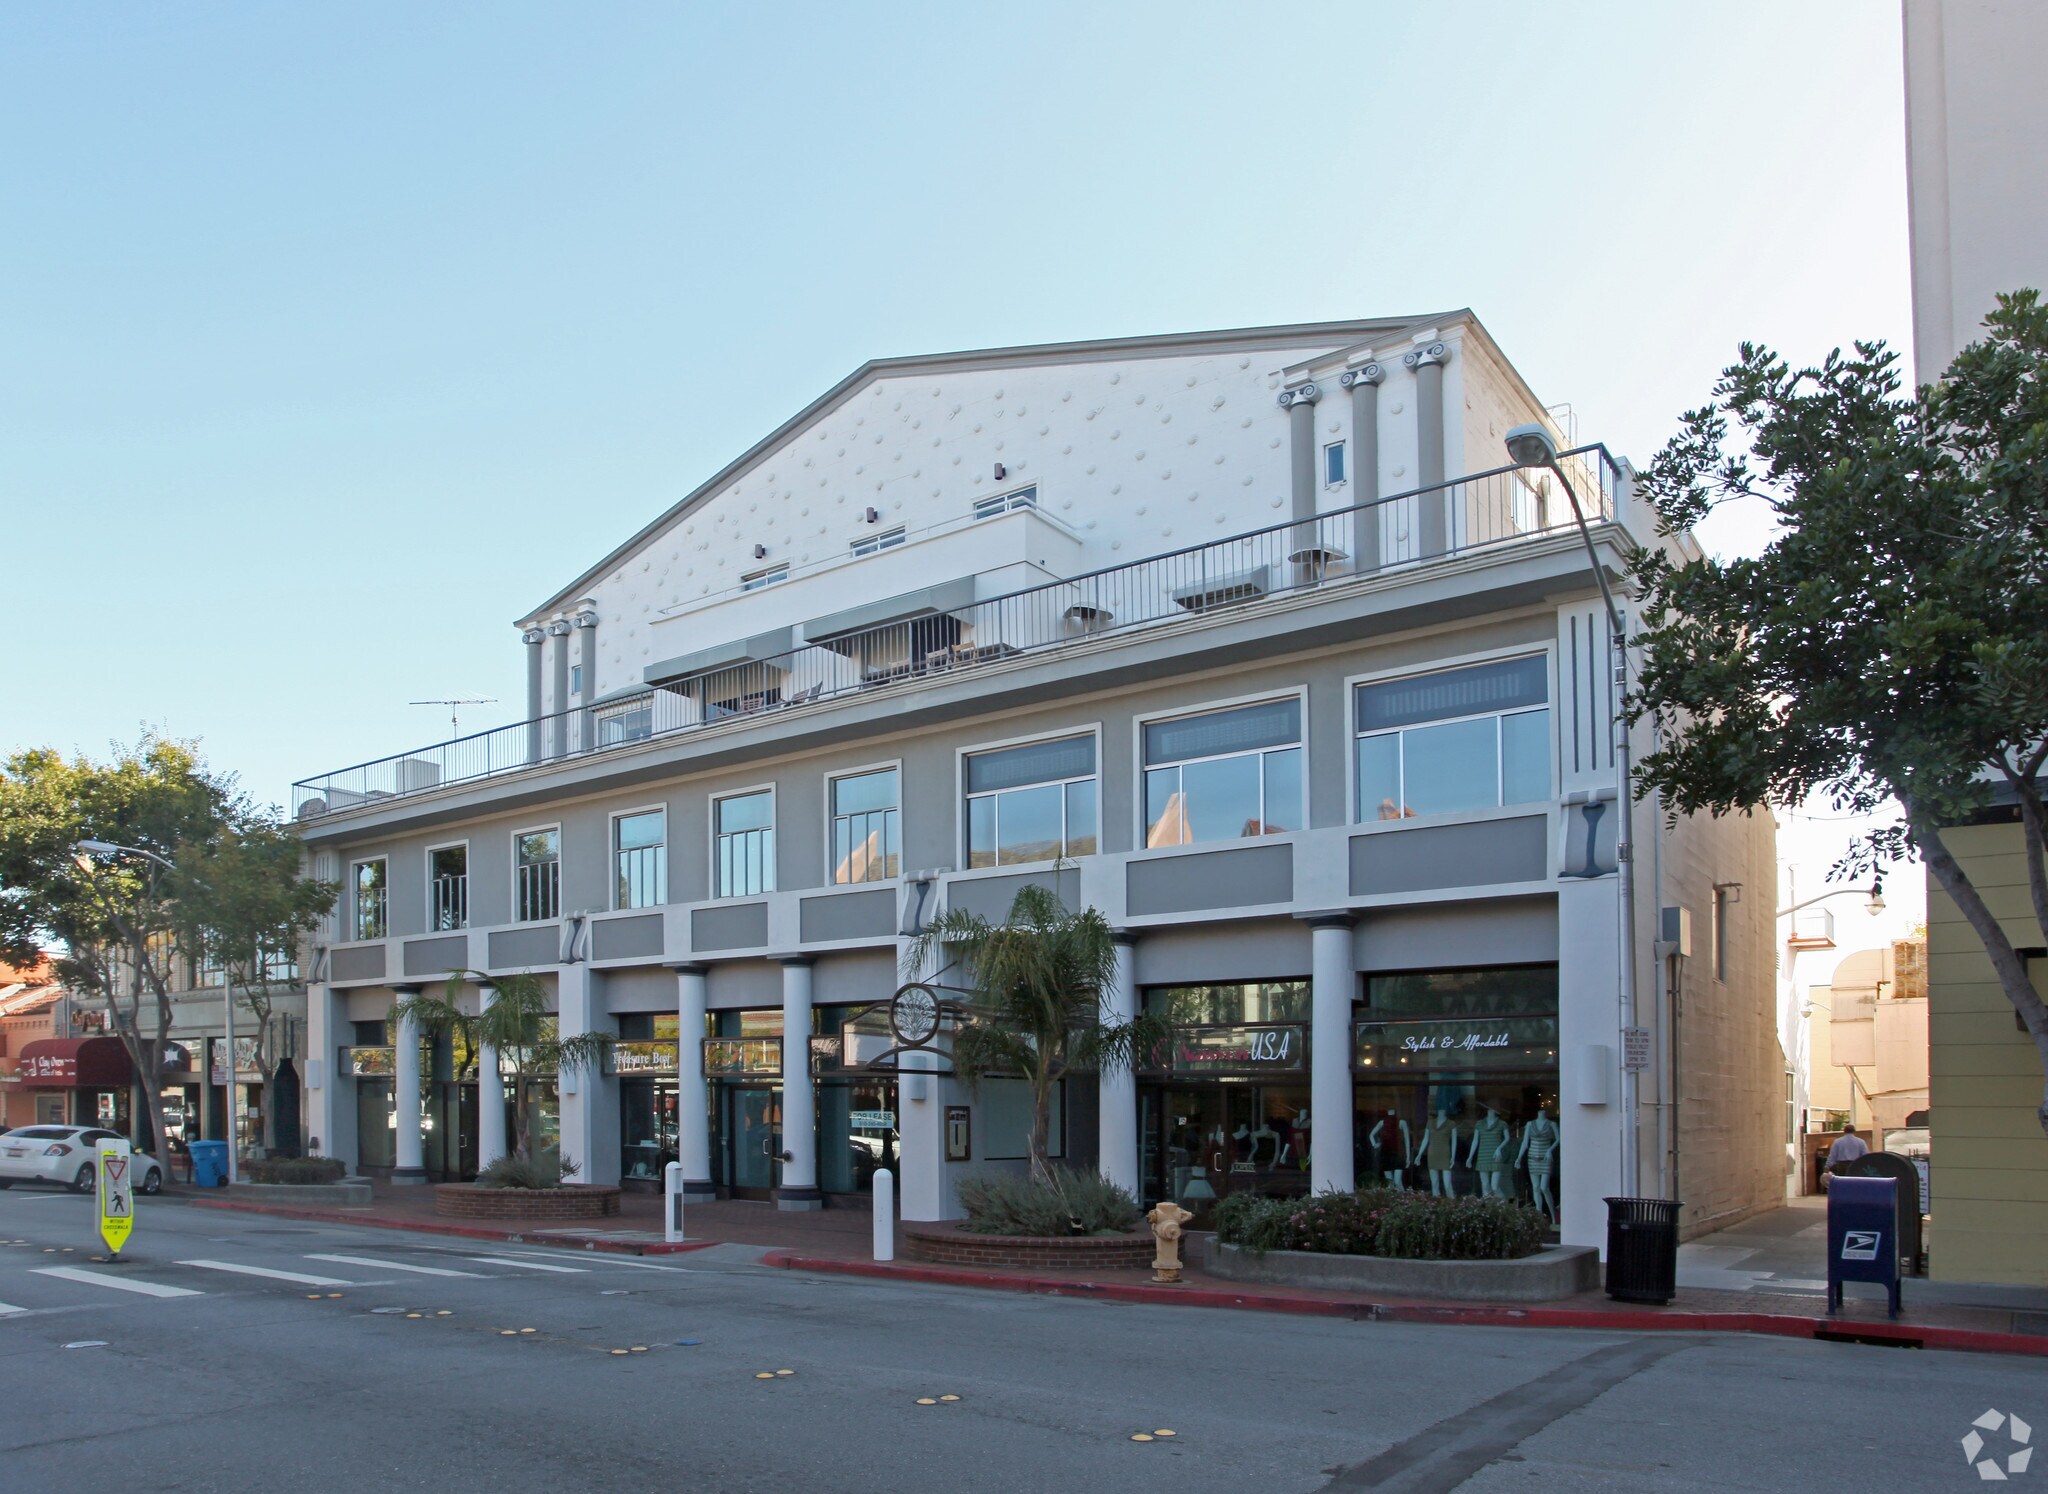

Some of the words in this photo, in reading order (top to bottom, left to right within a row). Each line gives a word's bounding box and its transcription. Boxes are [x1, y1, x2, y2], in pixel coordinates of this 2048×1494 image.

[1250, 1031, 1290, 1061] USA
[1400, 1036, 1436, 1053] Stylish
[1440, 1036, 1454, 1049] &
[1453, 1033, 1509, 1051] Affordable
[612, 1052, 650, 1065] Treasure
[852, 1112, 868, 1121] FOR
[869, 1112, 892, 1121] LEASE
